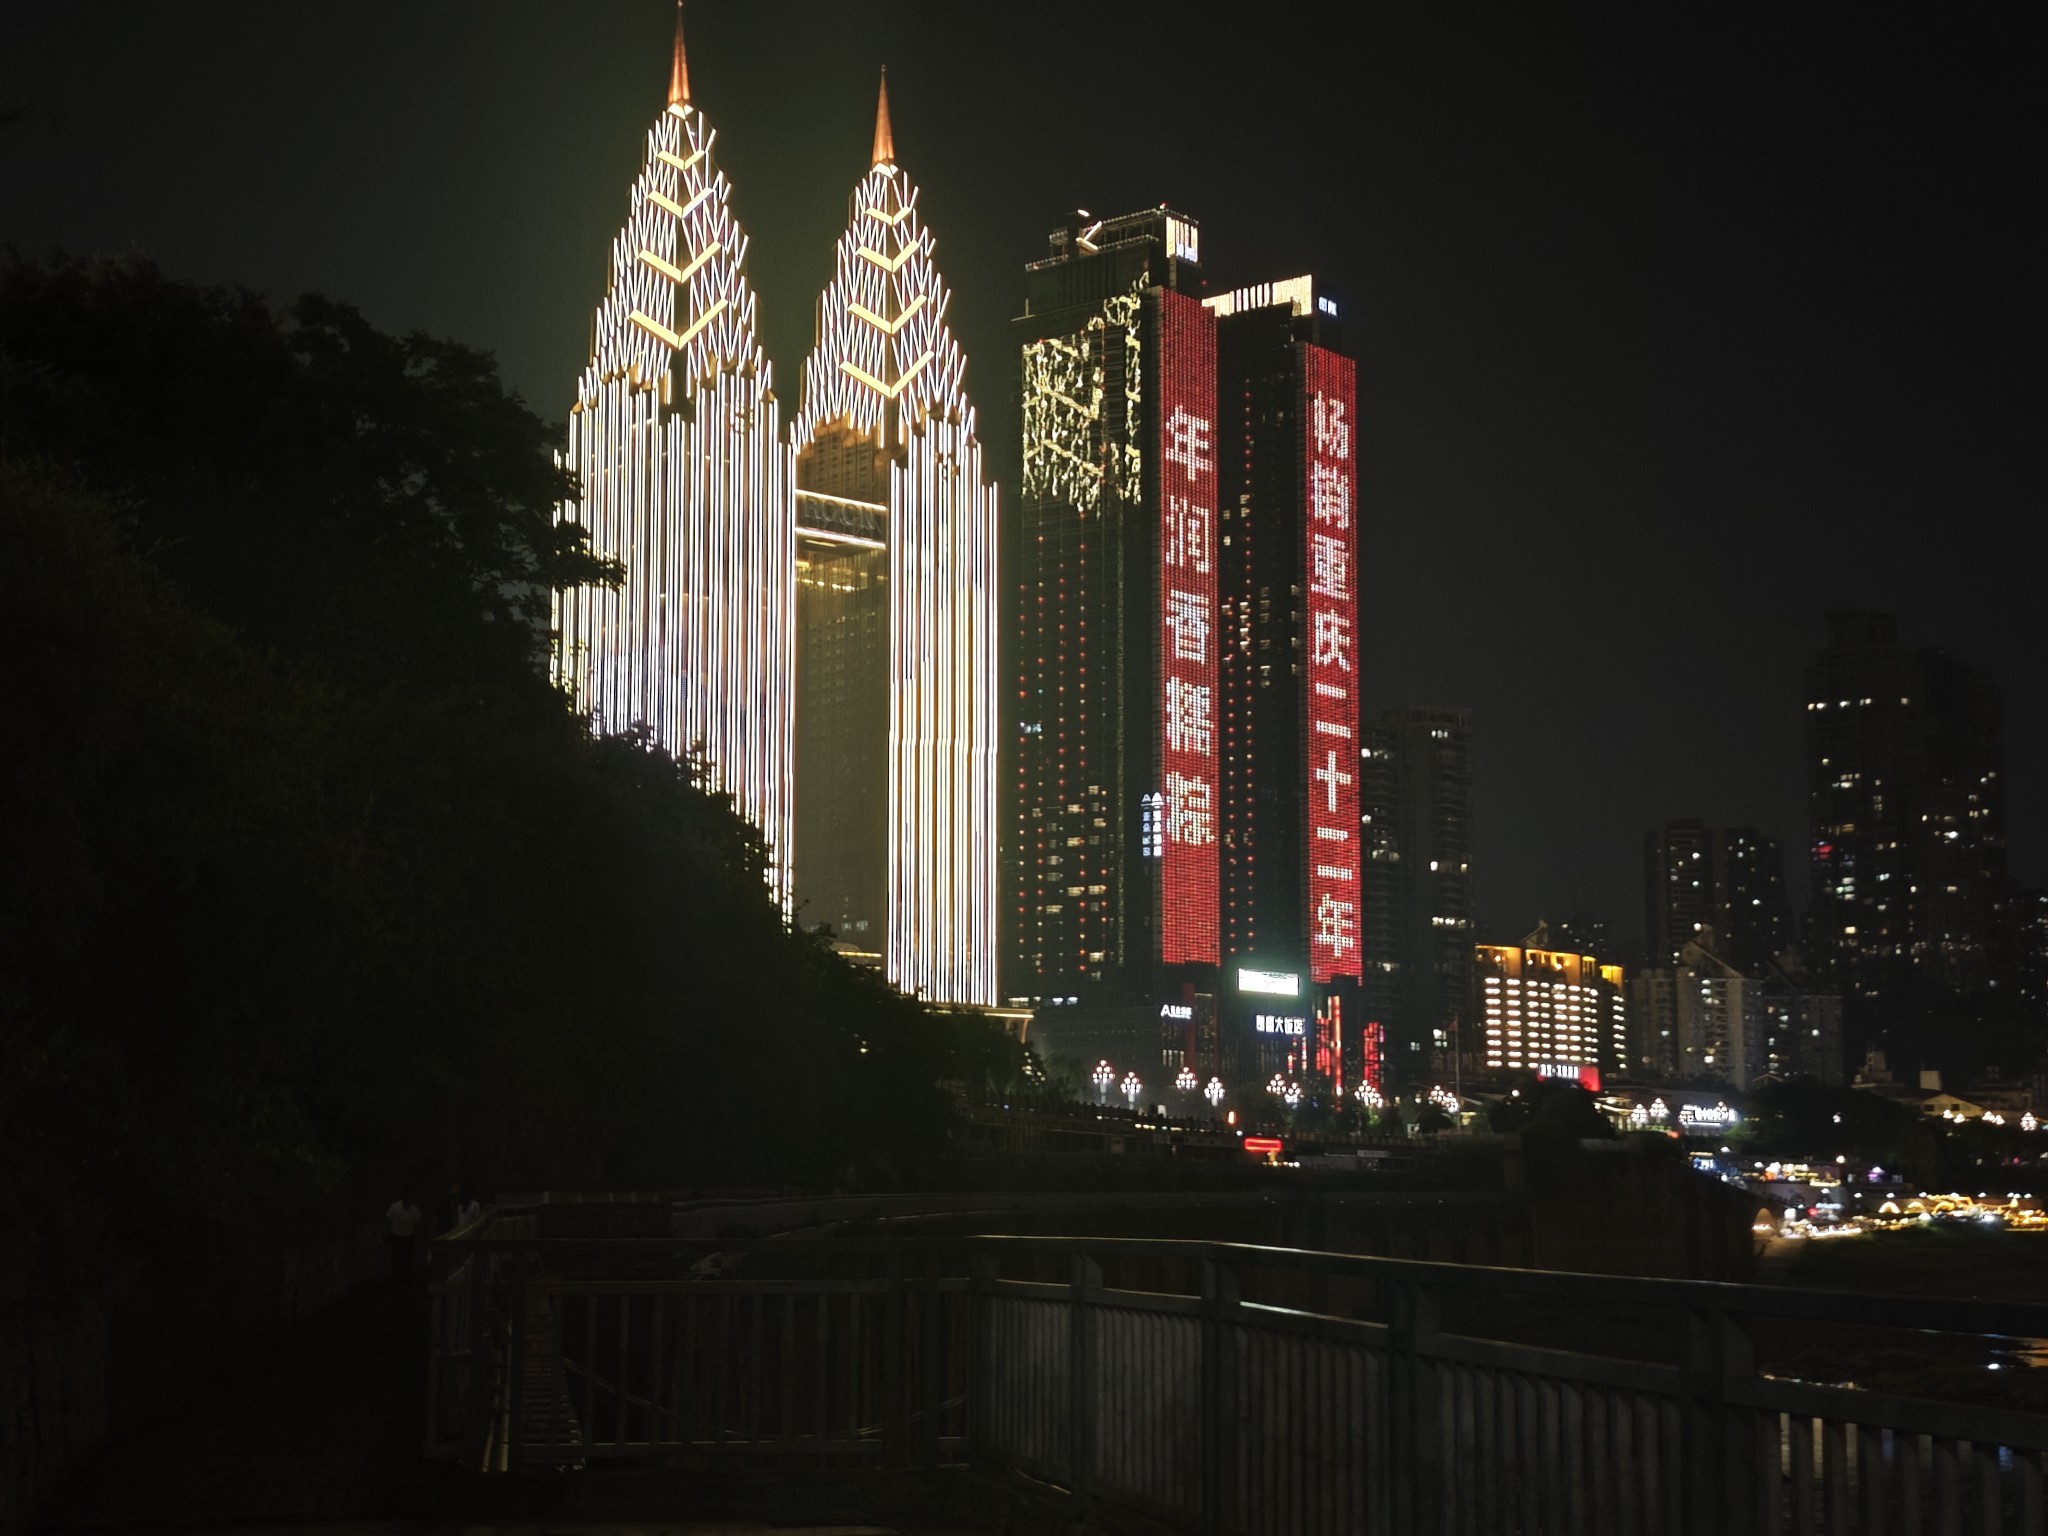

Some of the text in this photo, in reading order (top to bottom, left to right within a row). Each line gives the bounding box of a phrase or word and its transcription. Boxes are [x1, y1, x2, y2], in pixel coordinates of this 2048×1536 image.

[1311, 390, 1354, 958] 畅销重庆二十二年
